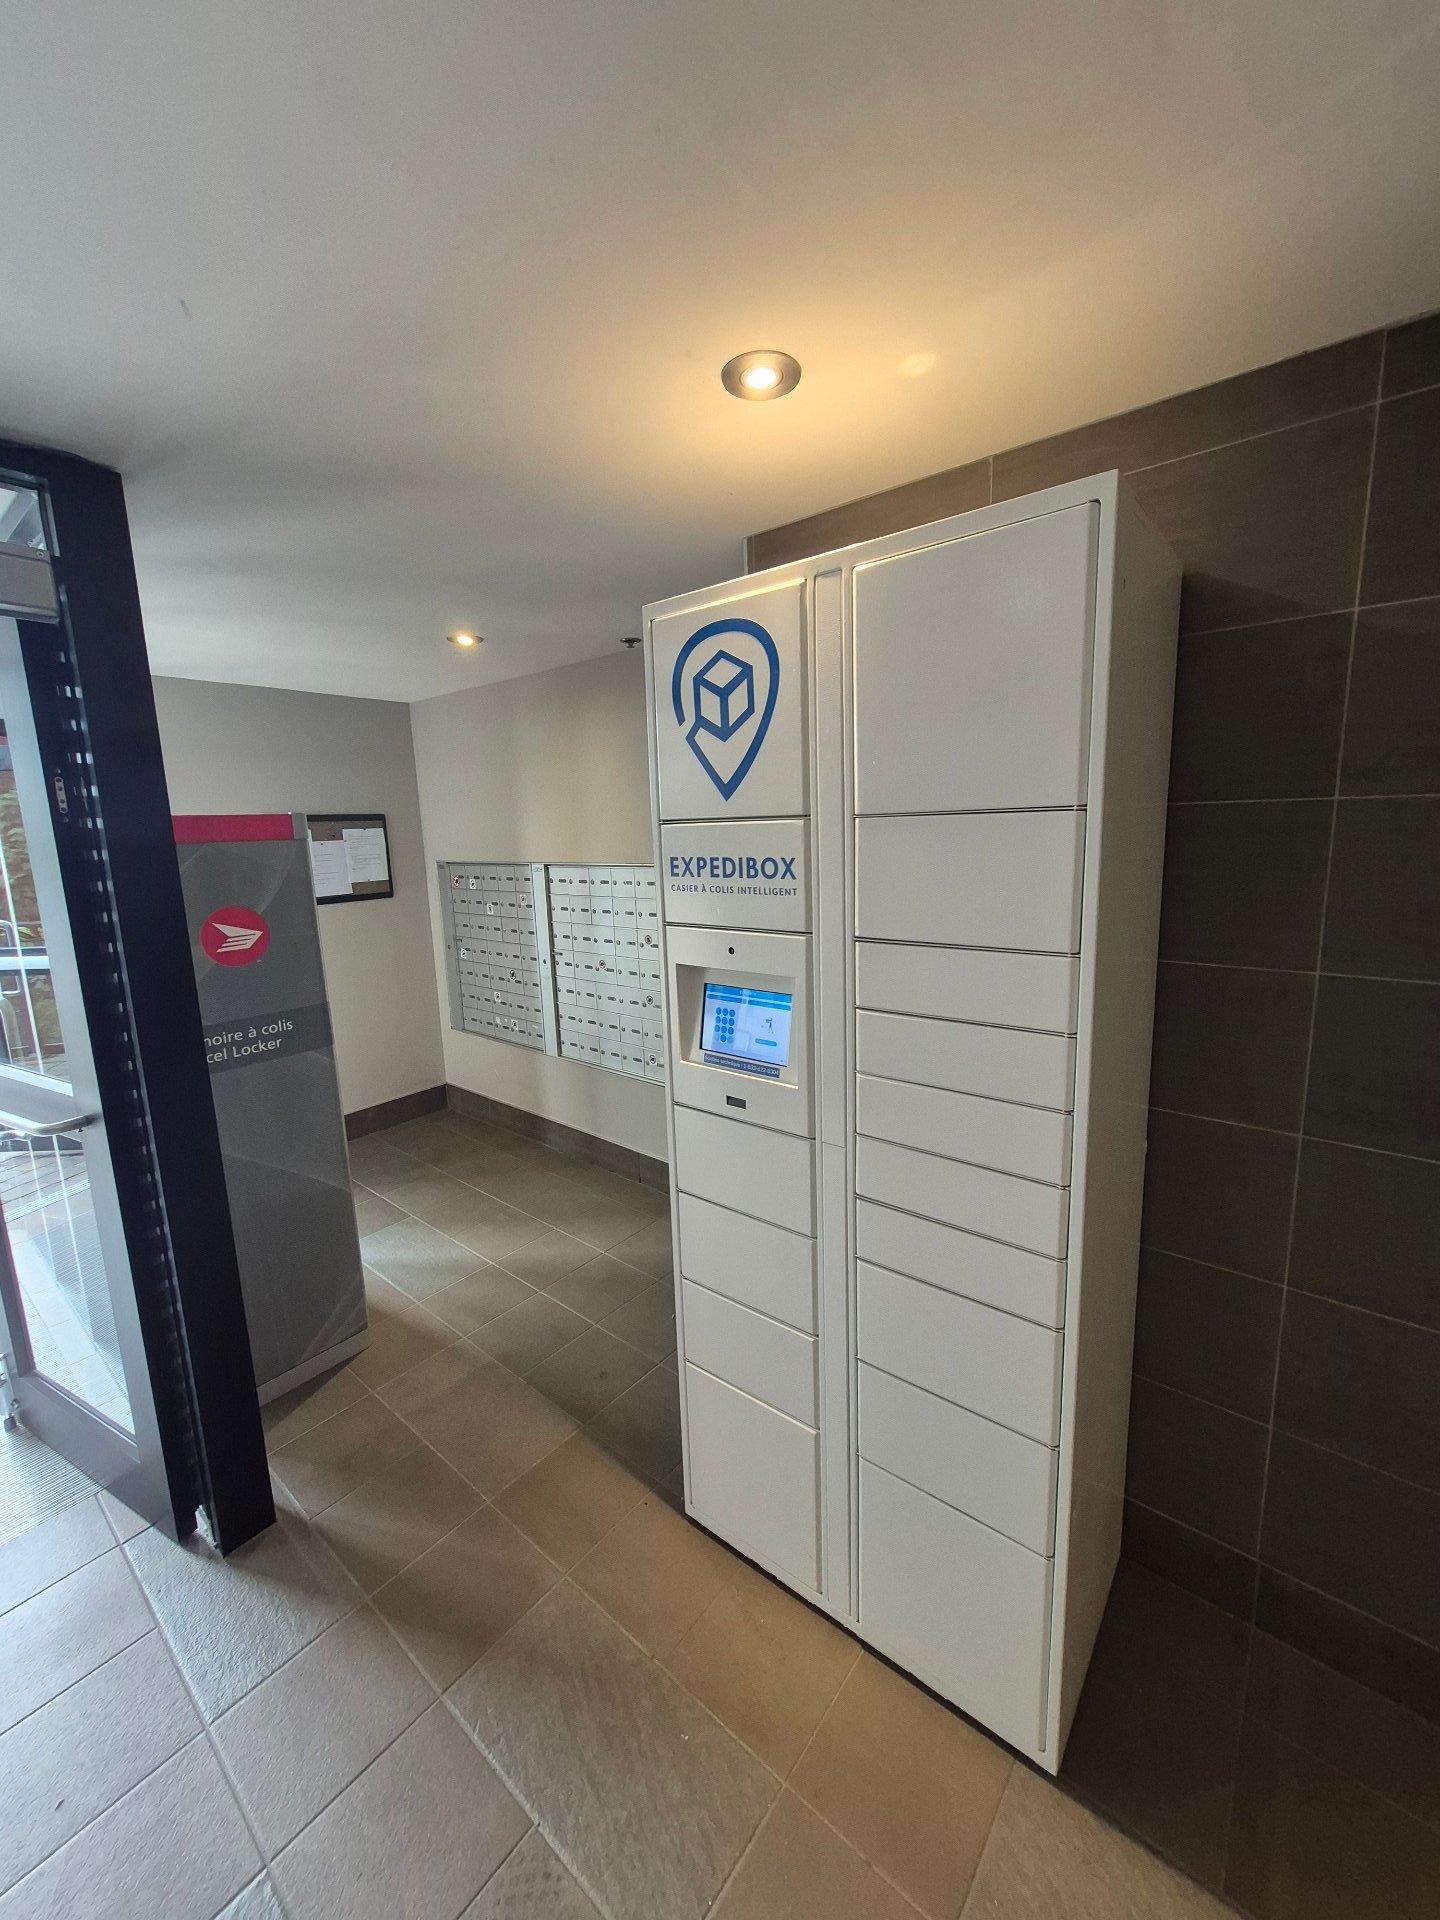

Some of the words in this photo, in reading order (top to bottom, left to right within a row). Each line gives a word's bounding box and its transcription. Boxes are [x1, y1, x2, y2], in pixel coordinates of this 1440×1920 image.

[669, 856, 797, 880] EXPEDIBOX
[671, 884, 699, 893] CASIER
[701, 883, 707, 893] À
[709, 885, 734, 894] COLIS
[737, 886, 797, 897] INTELLIGENT
[248, 1026, 257, 1038] à
[261, 1019, 293, 1035] colis
[232, 1038, 282, 1058] Locker
